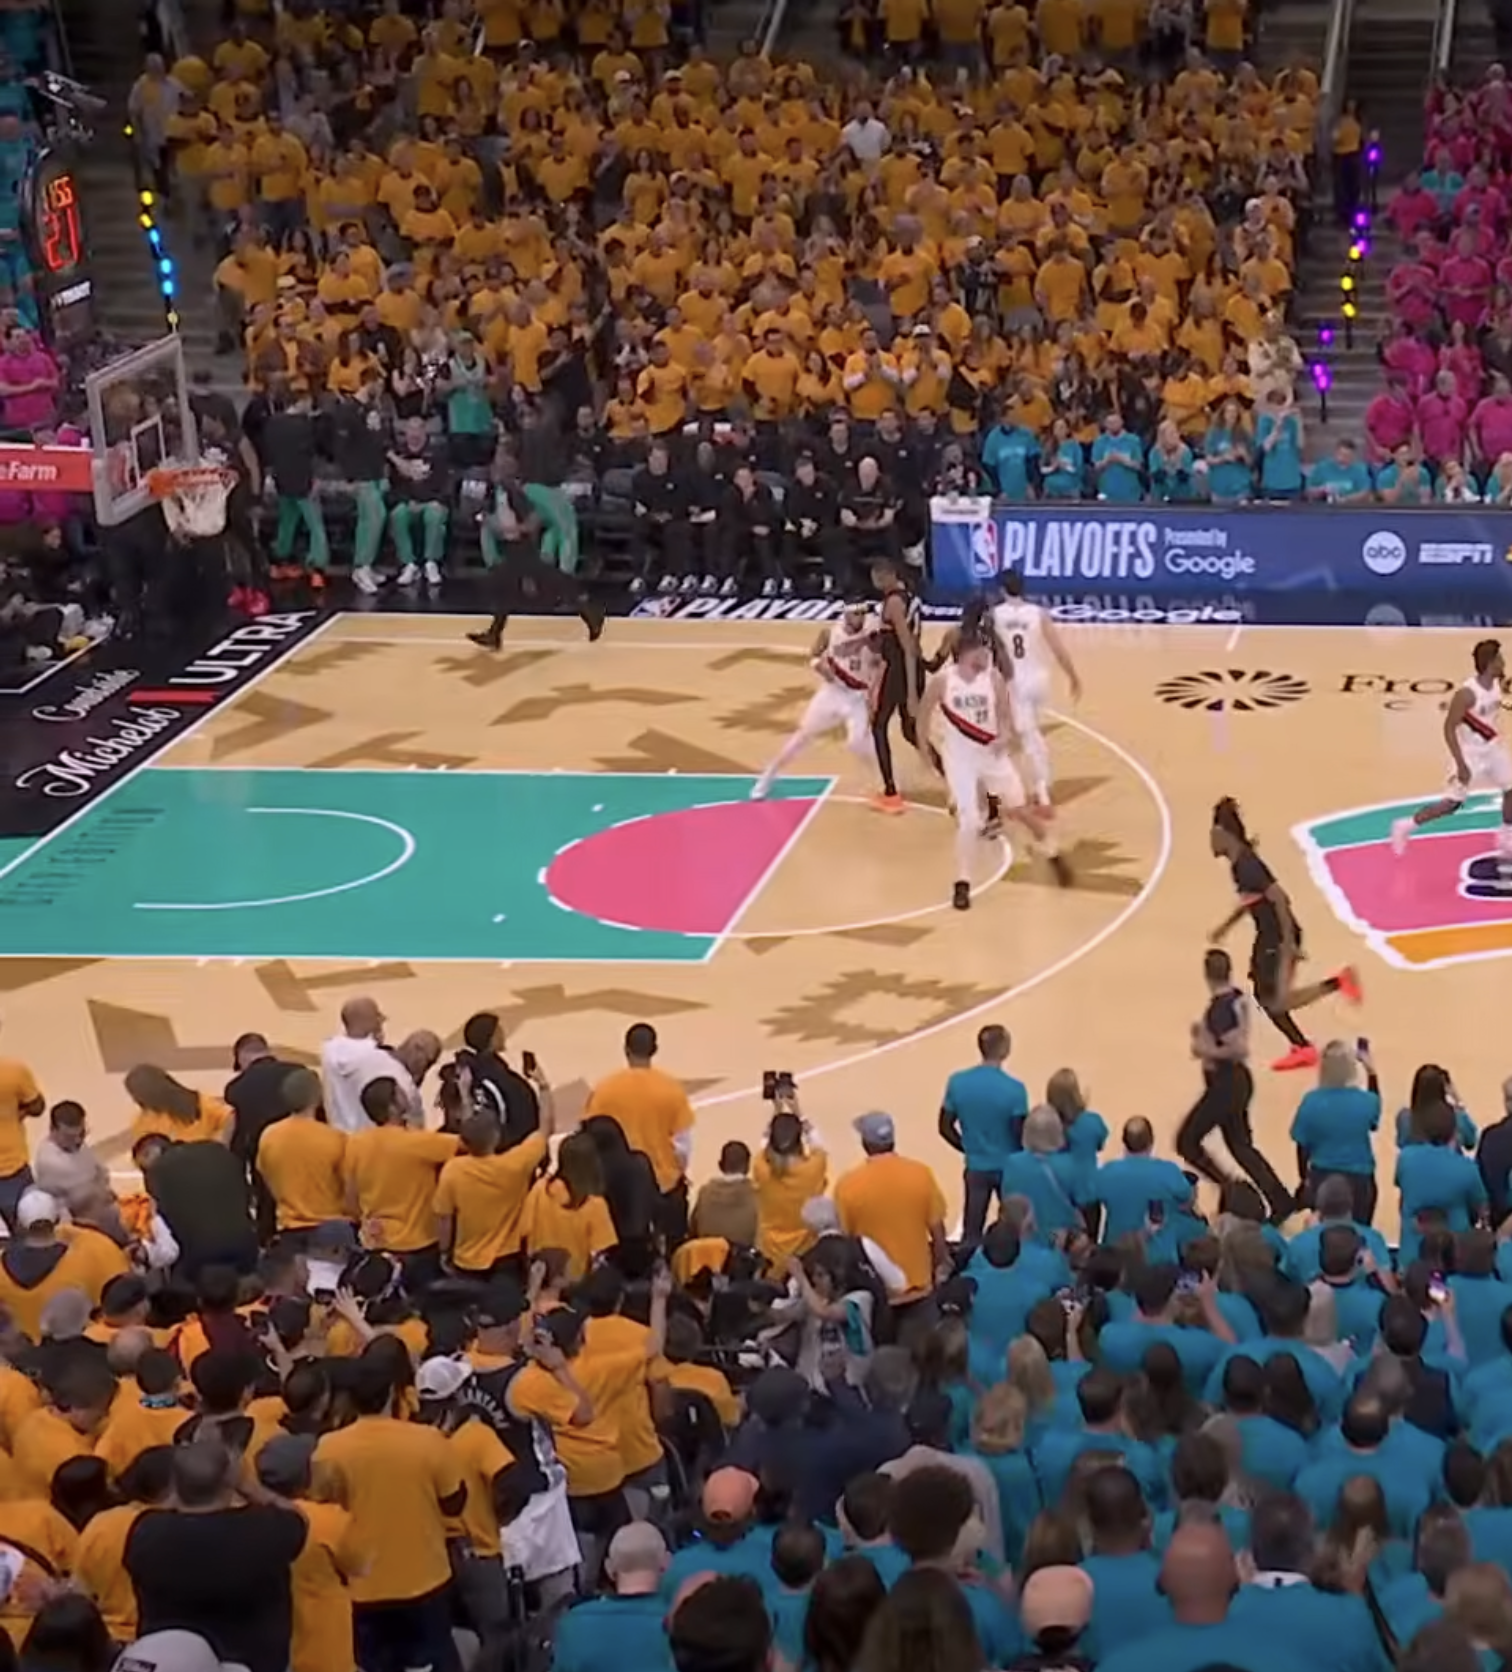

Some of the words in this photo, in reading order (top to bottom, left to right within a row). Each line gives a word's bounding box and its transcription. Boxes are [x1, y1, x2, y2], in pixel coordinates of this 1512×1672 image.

[1003, 521, 1156, 578] PLAYOFFS
[1366, 543, 1402, 559] abc
[1418, 543, 1493, 564] ESPN
[1164, 548, 1255, 579] Google
[675, 597, 882, 620] PLAYOF
[1051, 604, 1242, 624] Google
[1012, 633, 1025, 659] 8
[16, 706, 182, 797] Michelob
[169, 610, 317, 684] ULTRA
